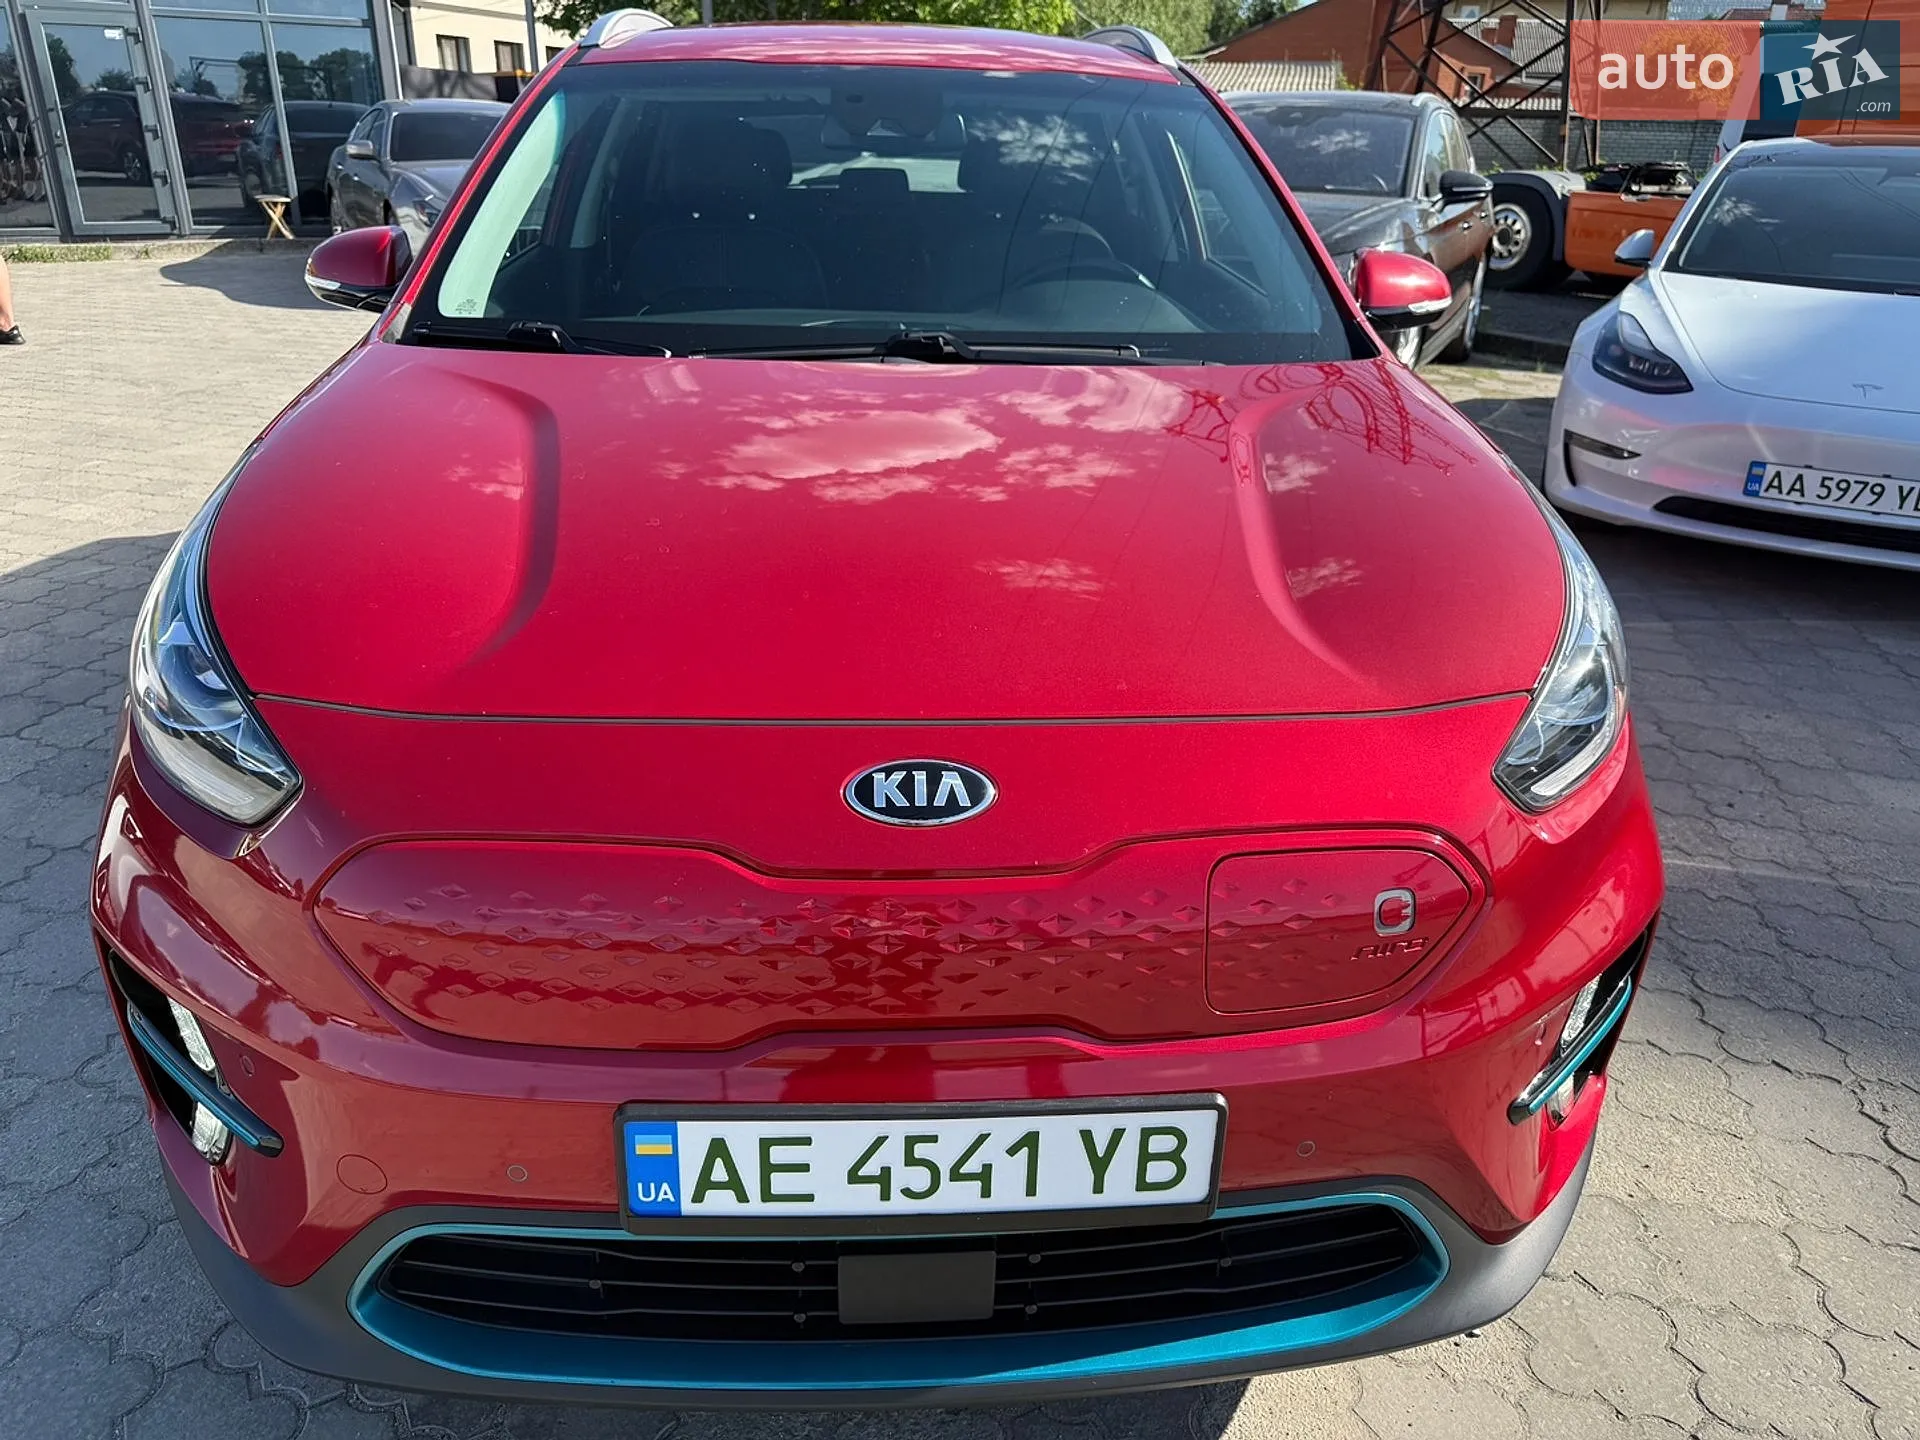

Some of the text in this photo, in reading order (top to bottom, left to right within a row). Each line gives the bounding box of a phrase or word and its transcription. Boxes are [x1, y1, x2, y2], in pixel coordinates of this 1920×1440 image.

[1763, 470, 1806, 498] AA
[1816, 476, 1886, 507] 5979
[872, 771, 972, 808] KIA
[690, 1126, 1189, 1204] AE 4541 YB
[637, 1182, 675, 1202] UA
